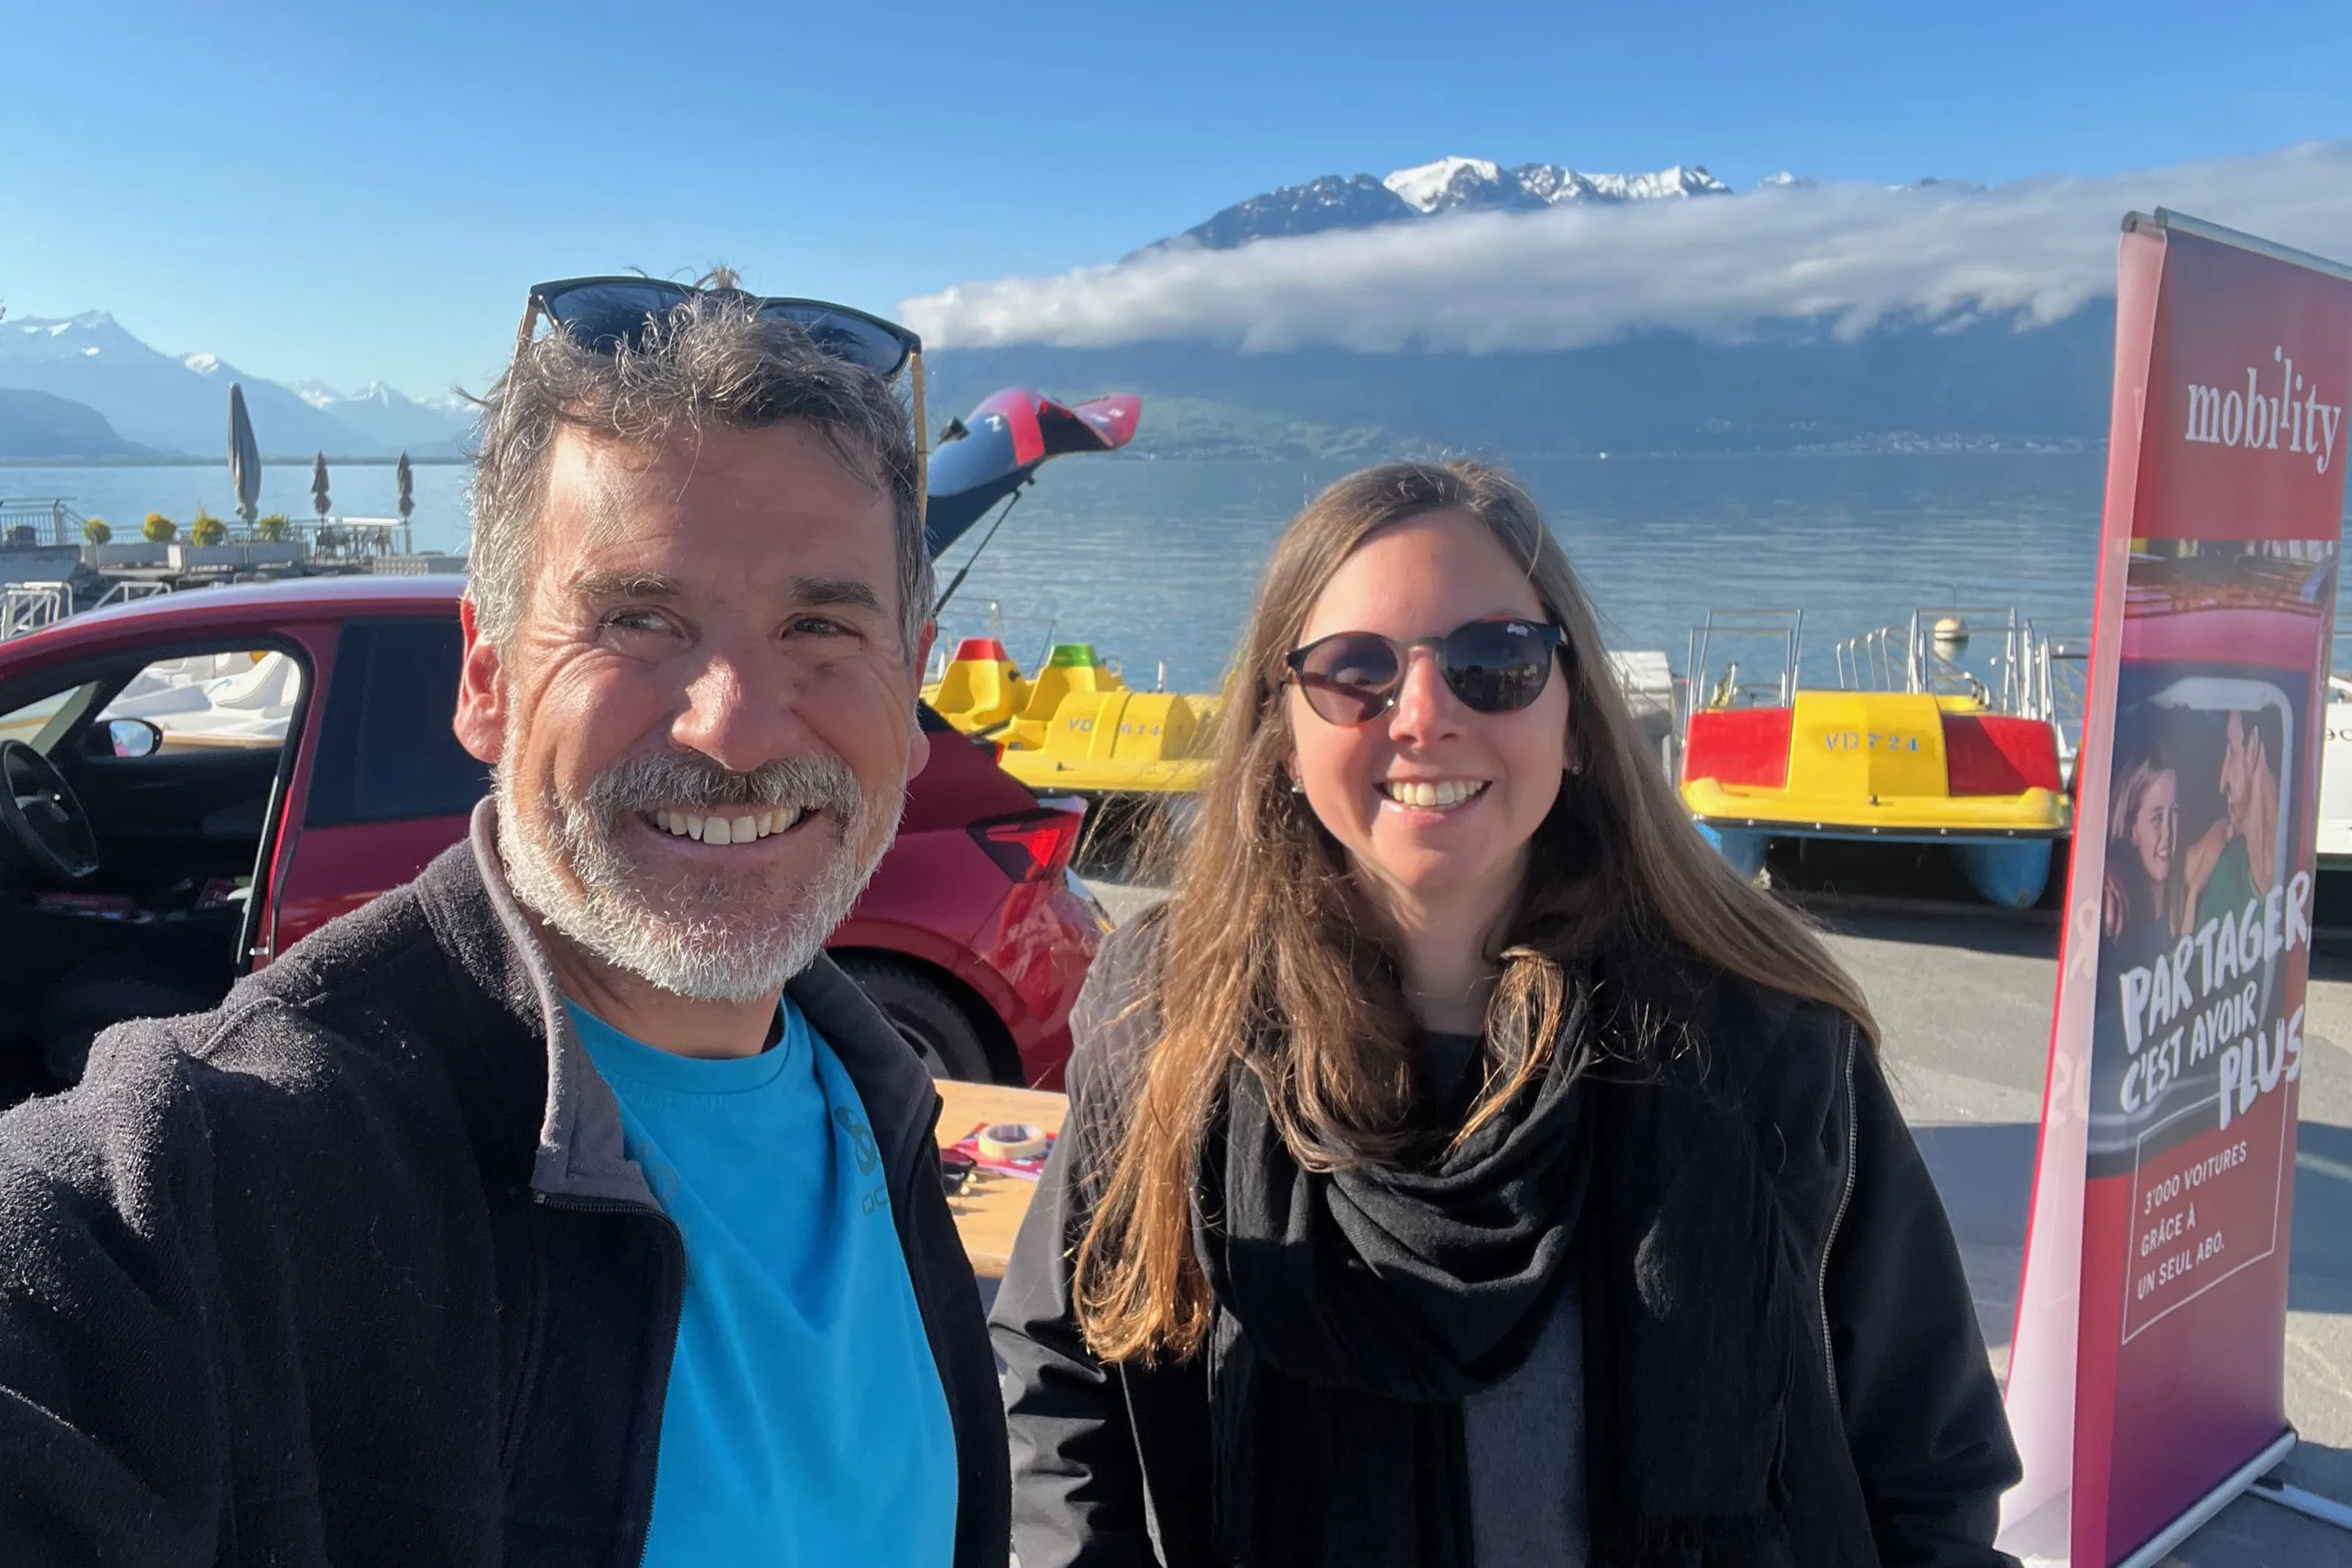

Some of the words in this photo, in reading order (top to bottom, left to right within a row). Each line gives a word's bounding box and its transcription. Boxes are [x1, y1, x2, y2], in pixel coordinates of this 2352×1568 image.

[2185, 345, 2342, 474] mobility
[1824, 732, 1859, 750] VD
[2120, 1025, 2184, 1112] C'EST
[2190, 980, 2258, 1067] AVOIR
[2219, 1004, 2304, 1131] PLUS
[2144, 1174, 2181, 1216] 3'000
[2184, 1140, 2248, 1191] VOITURES
[2186, 1201, 2196, 1230] À
[2137, 1269, 2156, 1301] UN
[2158, 1250, 2193, 1285] SEUL
[2196, 1231, 2226, 1265] ABO.
